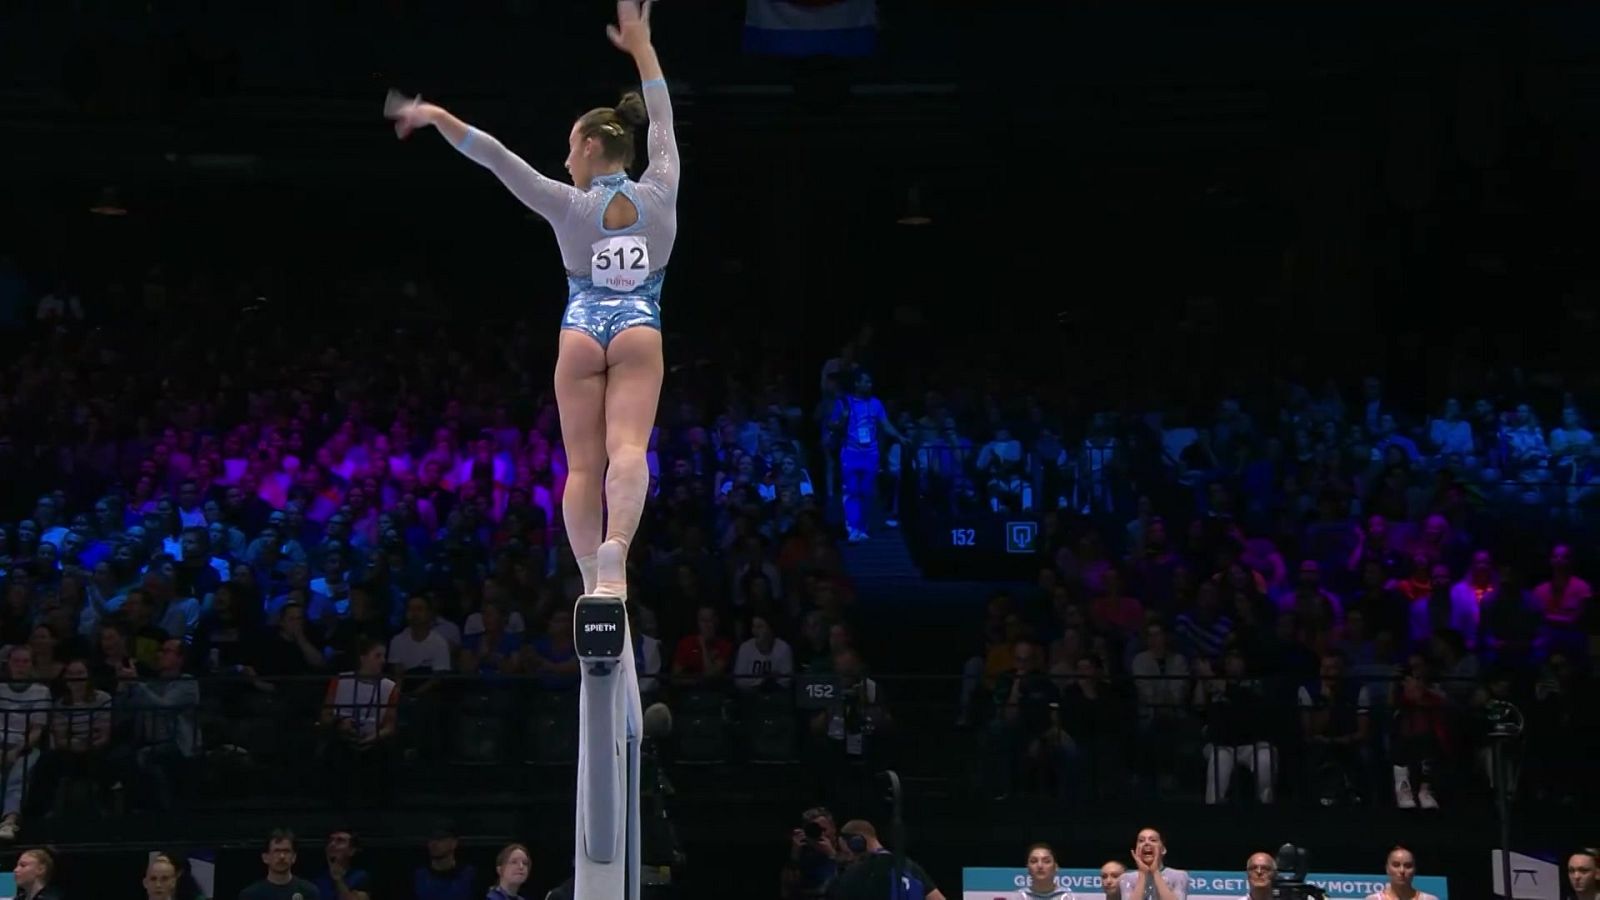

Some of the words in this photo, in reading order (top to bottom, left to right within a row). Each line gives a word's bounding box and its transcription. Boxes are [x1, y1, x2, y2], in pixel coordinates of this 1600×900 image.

[596, 247, 646, 270] 512
[951, 528, 977, 547] 152
[584, 623, 617, 632] SPIETH
[804, 683, 835, 699] 152
